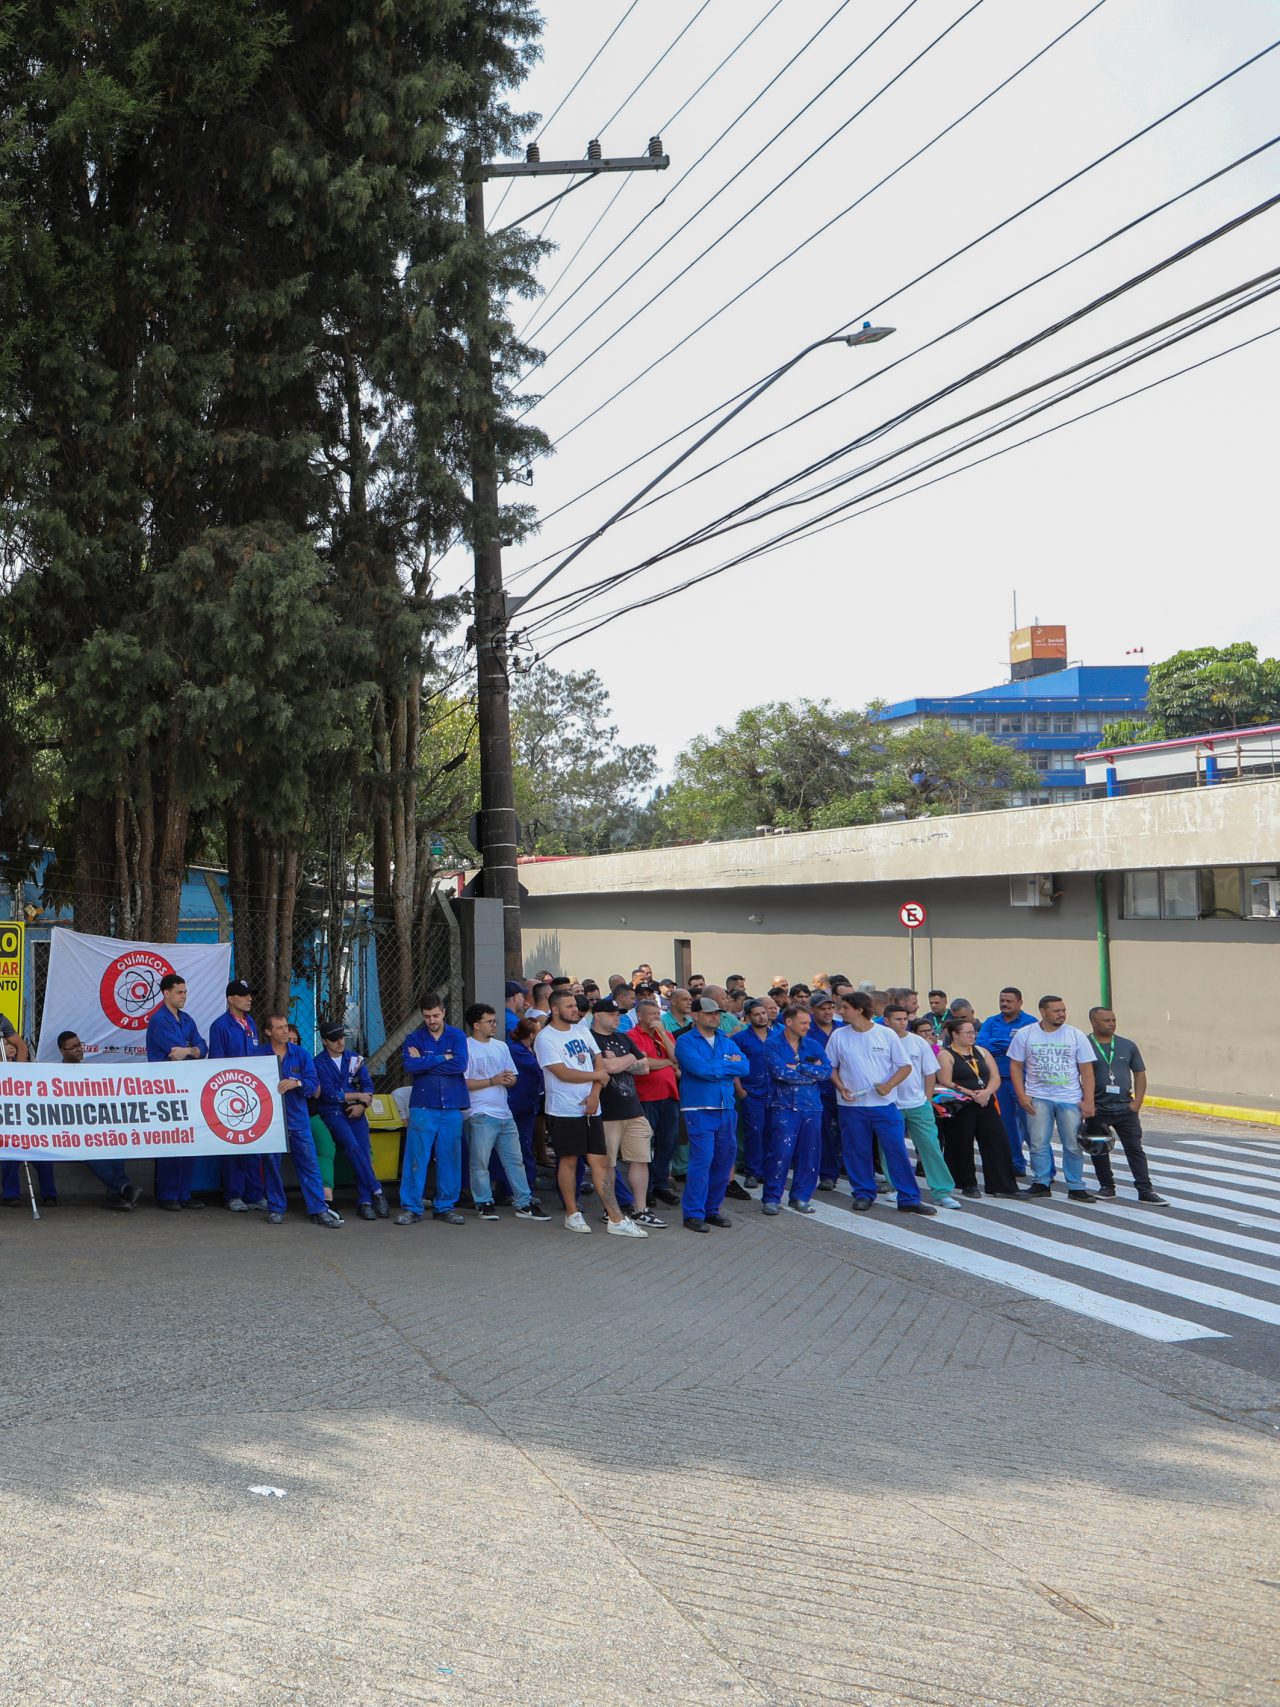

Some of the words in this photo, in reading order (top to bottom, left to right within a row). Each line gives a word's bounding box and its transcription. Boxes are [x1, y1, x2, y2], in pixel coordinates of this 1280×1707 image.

[117, 952, 168, 976] QUÍMICOS
[564, 1039, 590, 1058] NBA
[1031, 1048, 1071, 1057] LEAVE
[36, 1081, 48, 1097] a
[52, 1077, 189, 1097] Suvinil/Glasu...
[209, 1071, 258, 1090] QUÍMICOS
[26, 1100, 189, 1126] SINDICALIZE-SE!
[52, 1130, 81, 1148] não
[84, 1129, 128, 1148] estão
[131, 1128, 141, 1145] à
[143, 1126, 195, 1145] venda!
